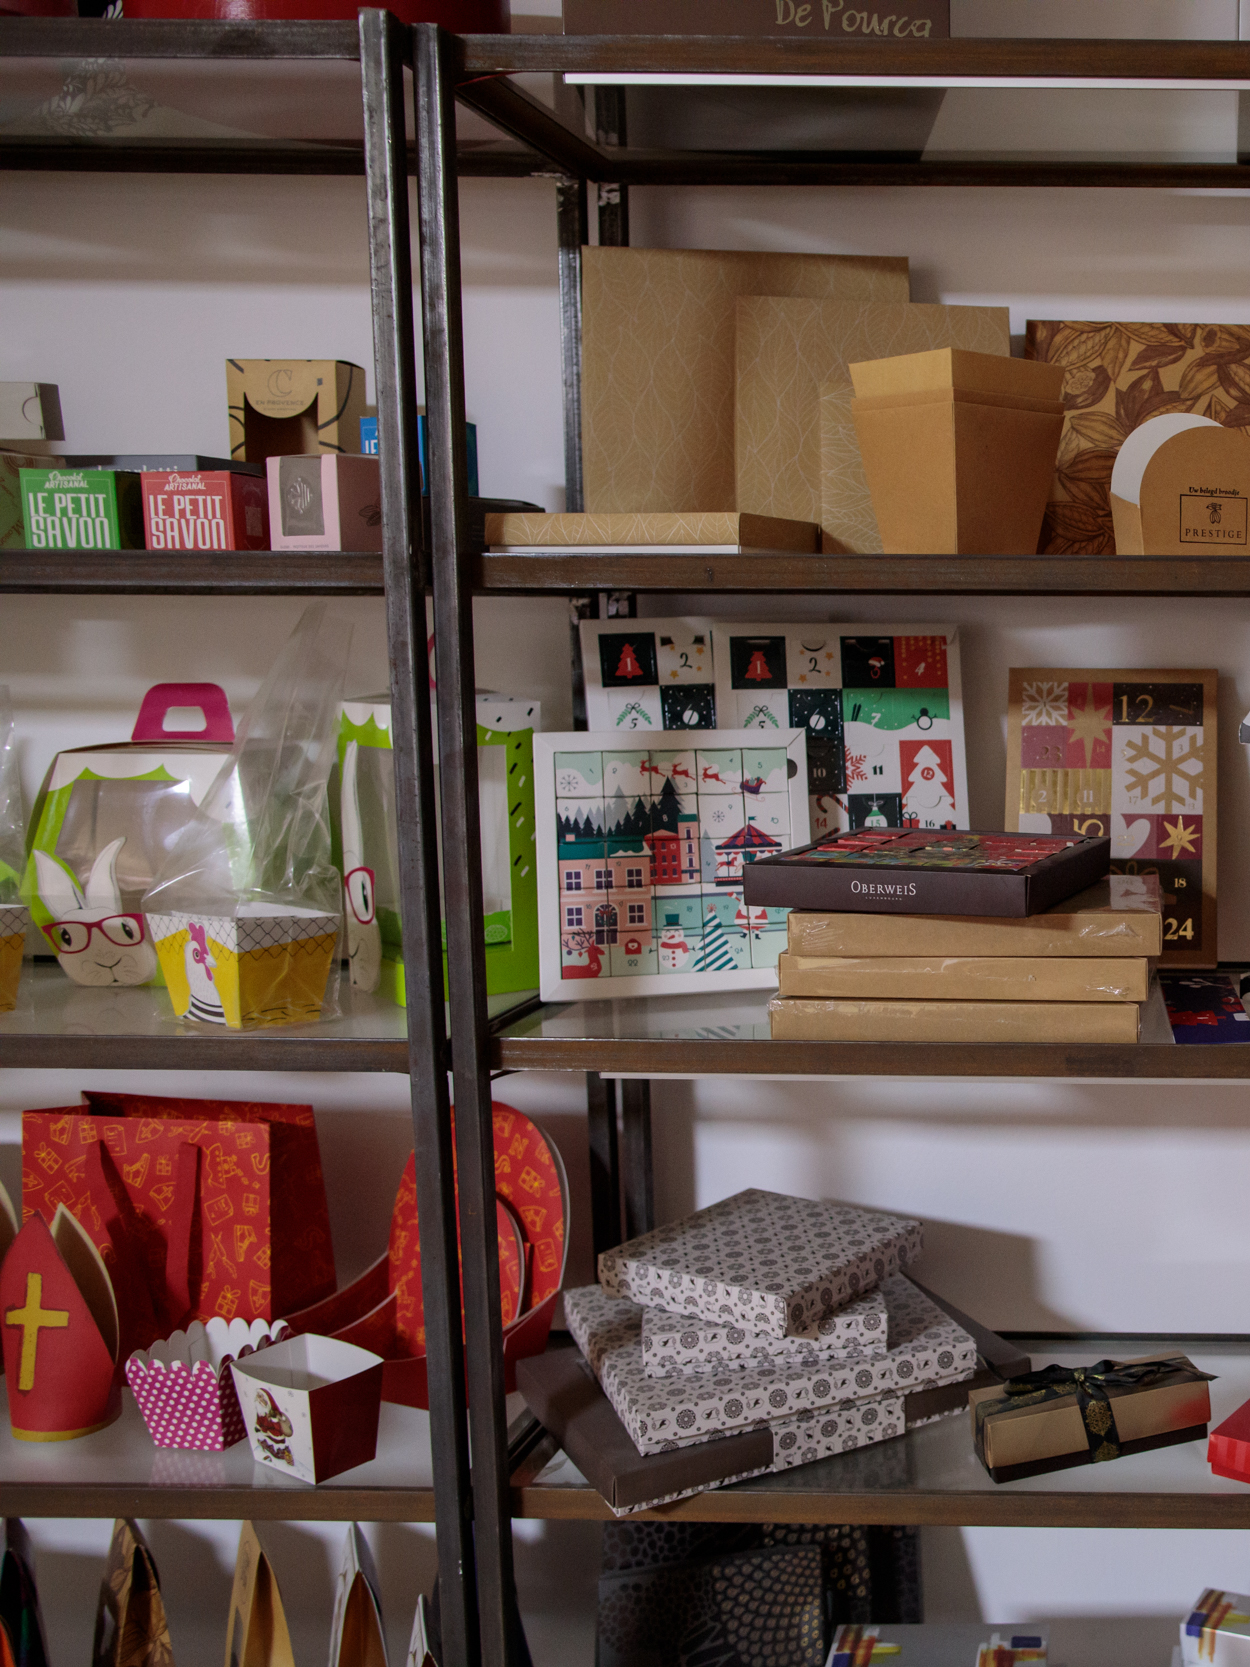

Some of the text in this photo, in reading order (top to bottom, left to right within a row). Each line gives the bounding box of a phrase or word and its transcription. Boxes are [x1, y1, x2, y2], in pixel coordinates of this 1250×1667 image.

[44, 480, 89, 489] ARTISANAL
[164, 482, 206, 491] ARTISANAL
[1188, 486, 1199, 494] Uw
[28, 492, 107, 518] LE PETIT
[149, 494, 223, 519] LE PETIT
[31, 516, 111, 549] SAVON
[151, 518, 227, 550] SAVON
[1184, 527, 1242, 539] PRESTIGE
[626, 657, 632, 672] 1
[679, 651, 694, 670] 2
[755, 660, 761, 675] 1
[807, 656, 822, 674] 2
[914, 661, 927, 677] 4
[1118, 694, 1154, 723] 12
[629, 717, 640, 730] 5
[870, 712, 882, 727] 7
[1177, 743, 1184, 754] 3
[756, 760, 763, 770] 5
[871, 764, 884, 776] 11
[811, 766, 827, 779] 10
[1037, 789, 1047, 803] 2
[1082, 789, 1094, 803] 11
[727, 803, 734, 811] 9
[661, 813, 668, 823] 8
[814, 816, 828, 830] 14
[923, 817, 935, 829] 16
[850, 880, 917, 896] OBERWEIS
[1173, 877, 1187, 889] 18
[1163, 917, 1195, 941] 24
[626, 958, 638, 968] 22
